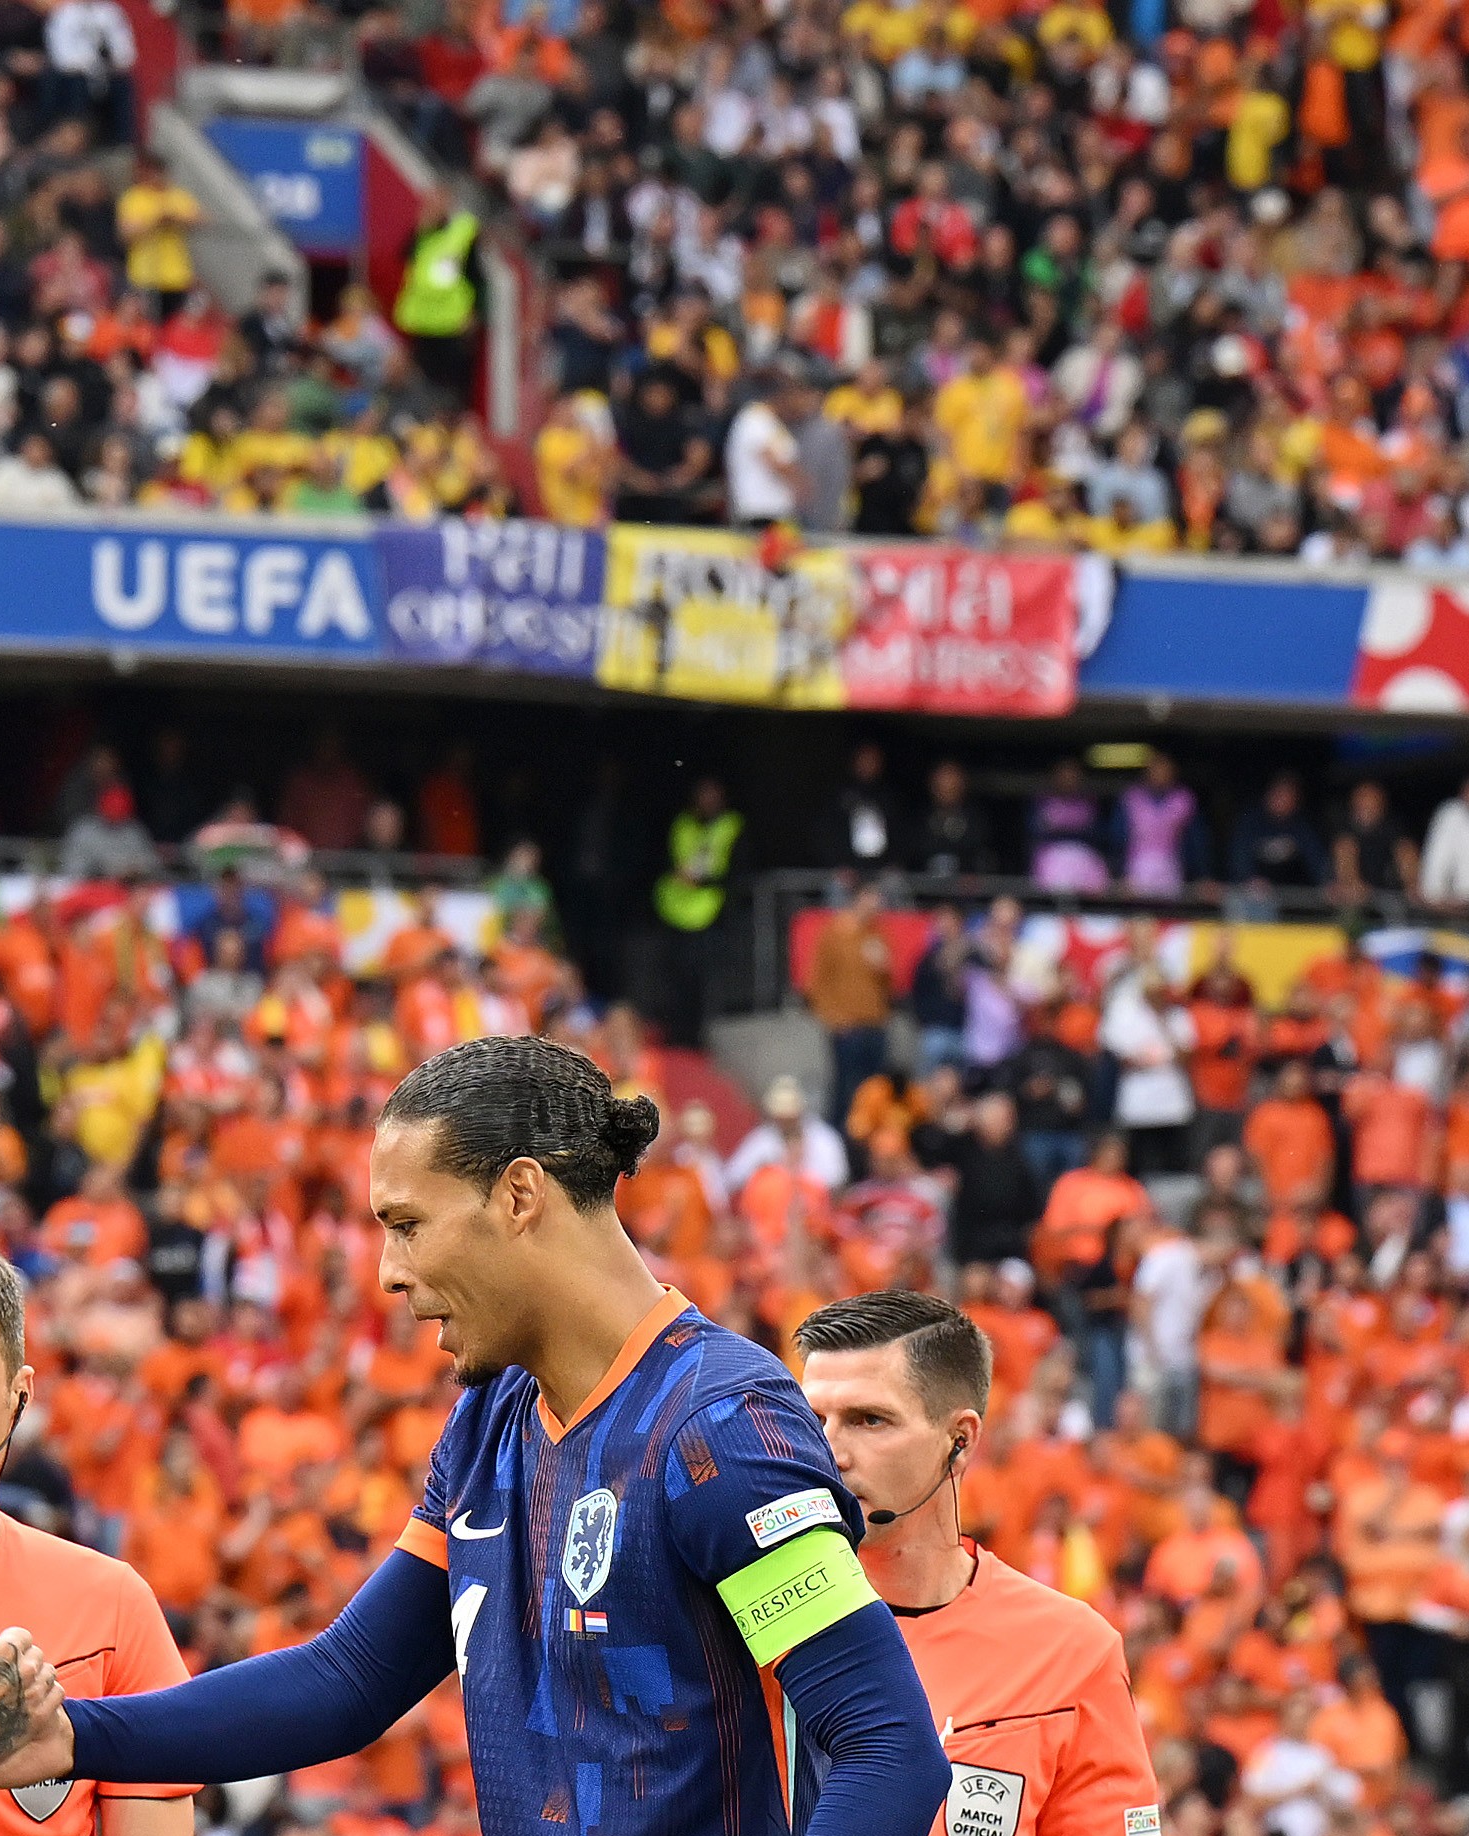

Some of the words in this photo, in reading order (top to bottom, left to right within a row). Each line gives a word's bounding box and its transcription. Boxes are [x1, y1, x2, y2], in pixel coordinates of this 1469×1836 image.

[91, 537, 374, 641] UEFA
[750, 1507, 773, 1524] UEFA
[753, 1499, 836, 1537] FOUNDATION
[751, 1567, 830, 1625] RESPECT
[962, 1778, 1005, 1801] UEFA
[960, 1807, 1003, 1826] MATCH
